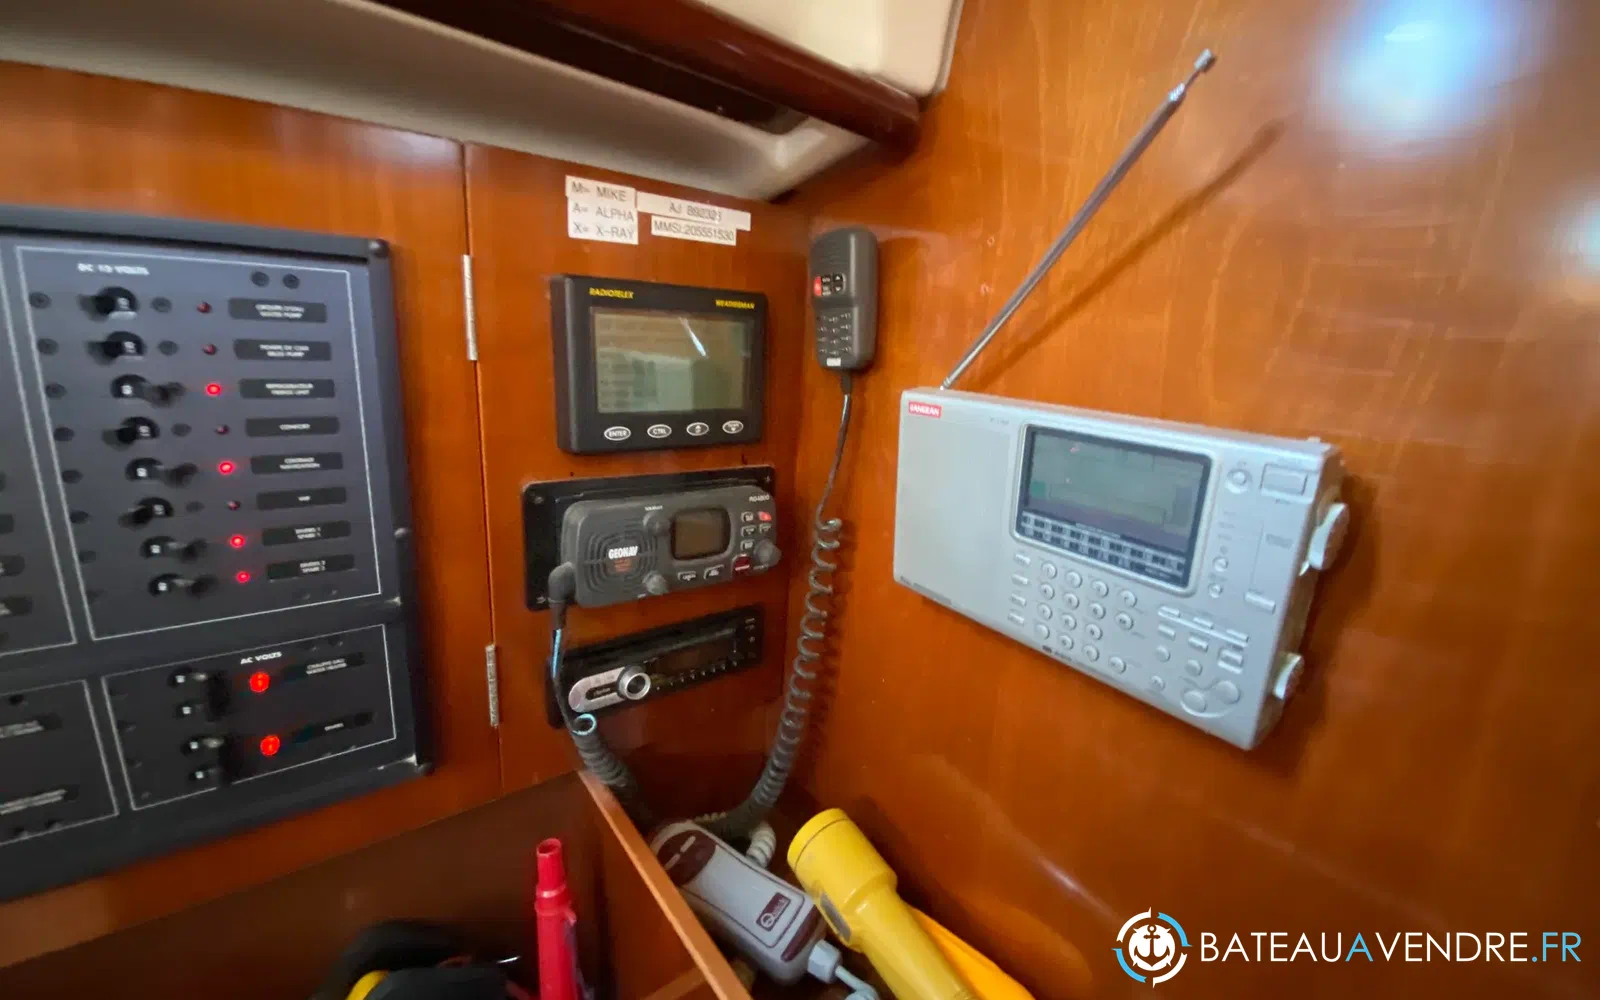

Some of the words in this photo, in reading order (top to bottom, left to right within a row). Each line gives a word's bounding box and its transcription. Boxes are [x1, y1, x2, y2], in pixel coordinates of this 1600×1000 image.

[596, 185, 627, 202] MIKE
[596, 206, 634, 222] ALPHA
[596, 224, 634, 240] X-RAY
[608, 429, 628, 438] ENTER
[652, 427, 667, 436] CTRL
[608, 546, 639, 559] GEONAV
[240, 657, 254, 665] AC
[255, 651, 283, 662] VOLTS
